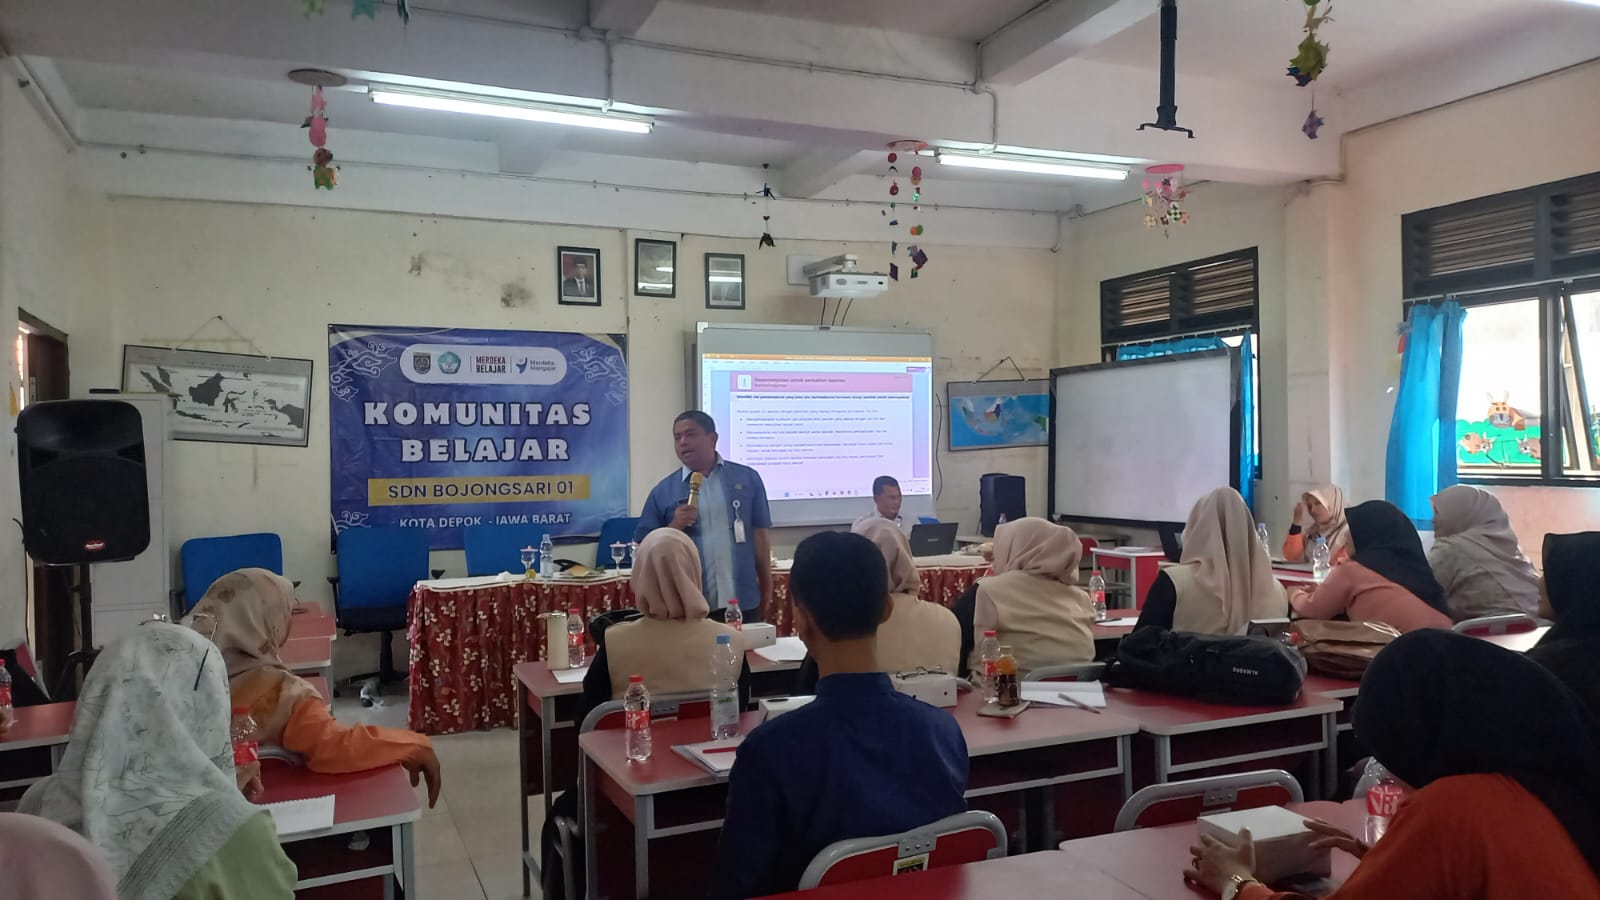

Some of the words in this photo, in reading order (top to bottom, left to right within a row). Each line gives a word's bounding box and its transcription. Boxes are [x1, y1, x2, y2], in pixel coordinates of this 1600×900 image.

[476, 356, 506, 365] MERDEKA
[476, 364, 506, 374] BELAJAR
[363, 401, 592, 426] KOMUNITAS
[401, 438, 570, 462] BELAJAR
[388, 484, 427, 499] SDN
[433, 481, 551, 498] BOJONGSARI
[556, 480, 573, 495] 01
[399, 517, 436, 529] KOTA
[438, 516, 482, 529] DEPOK
[532, 513, 571, 525] BARAT
